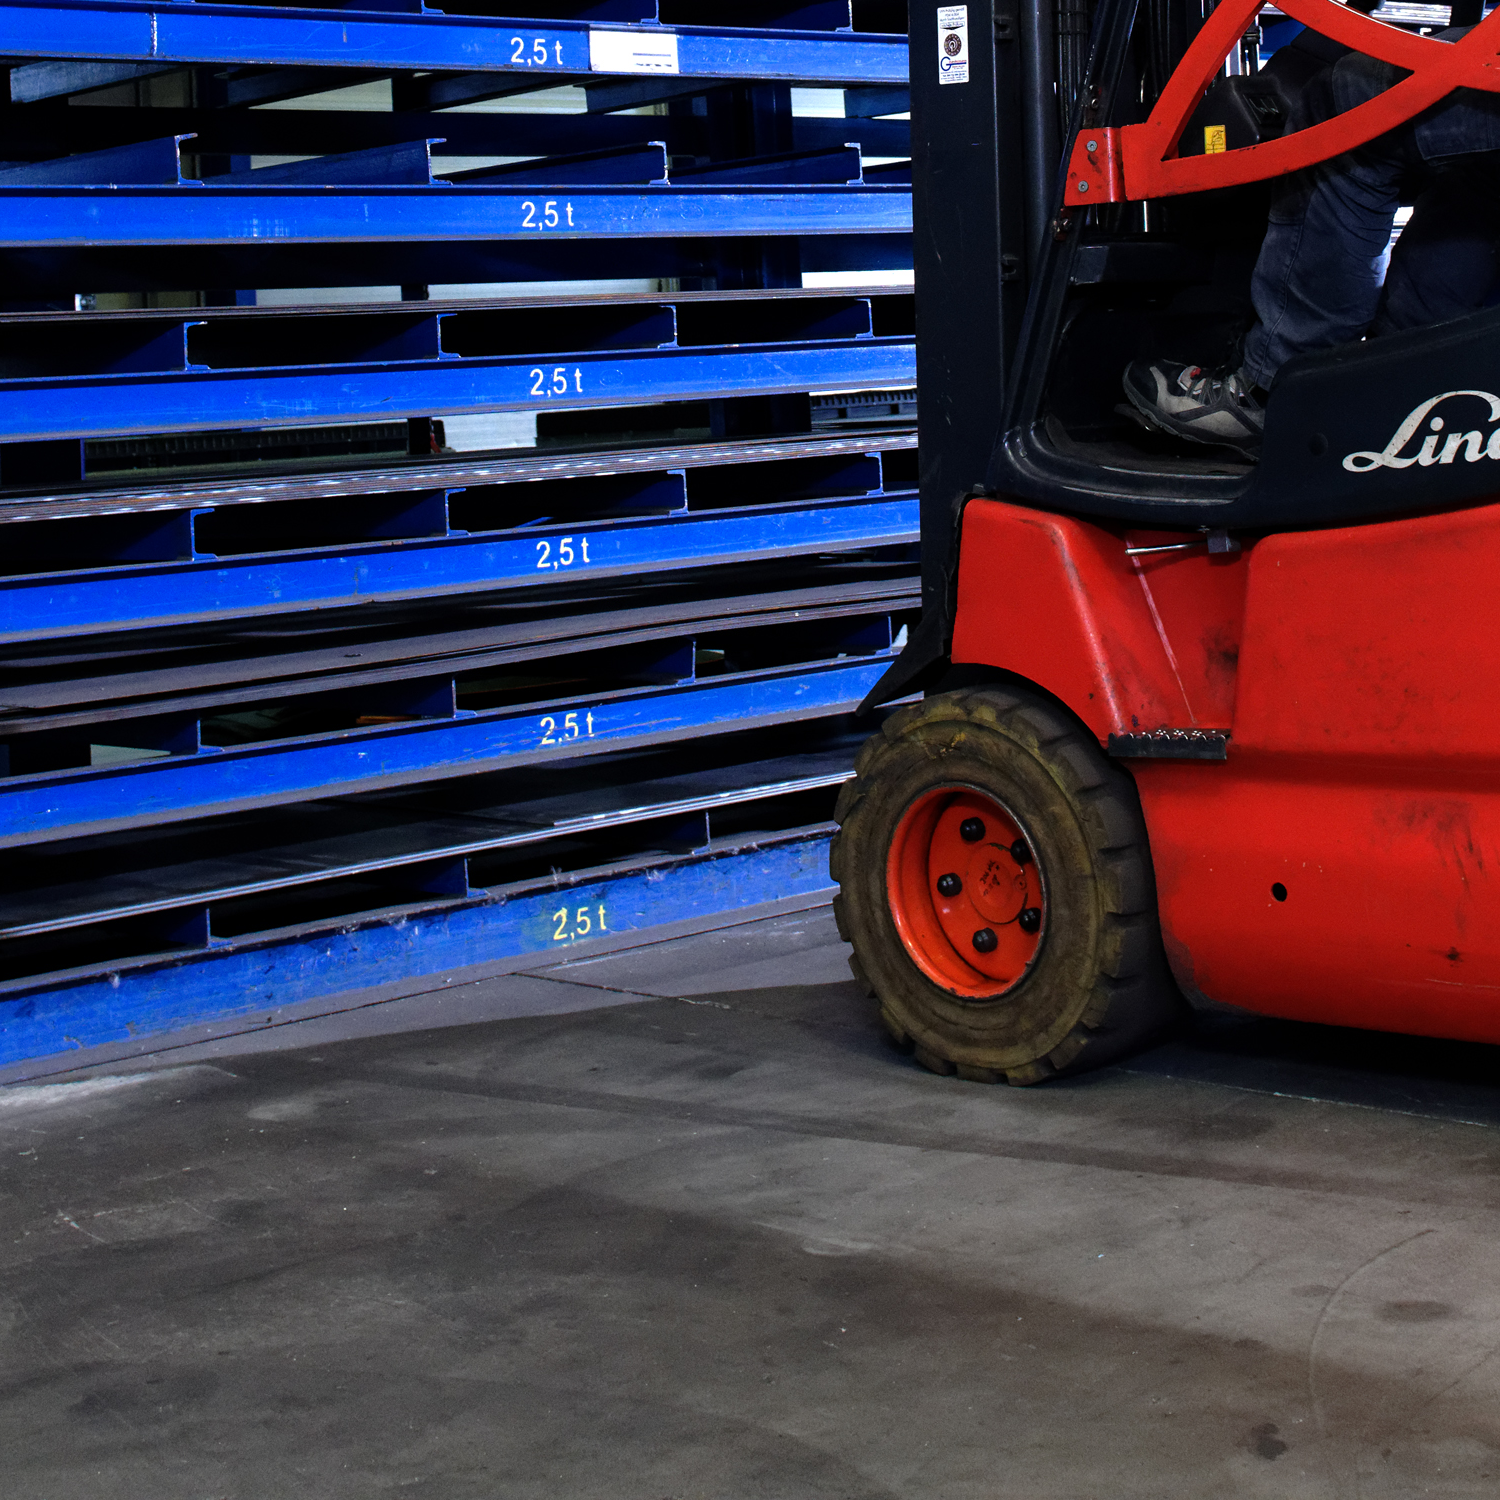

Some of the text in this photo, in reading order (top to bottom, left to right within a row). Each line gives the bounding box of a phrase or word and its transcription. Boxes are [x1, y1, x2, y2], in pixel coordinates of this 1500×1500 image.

[510, 36, 564, 67] 2,5 t
[522, 201, 575, 231] 2,5 t
[530, 367, 583, 398] 2,5 t
[537, 537, 591, 570] 2,5 t
[586, 711, 595, 738] t
[552, 905, 608, 942] 2,5 t
